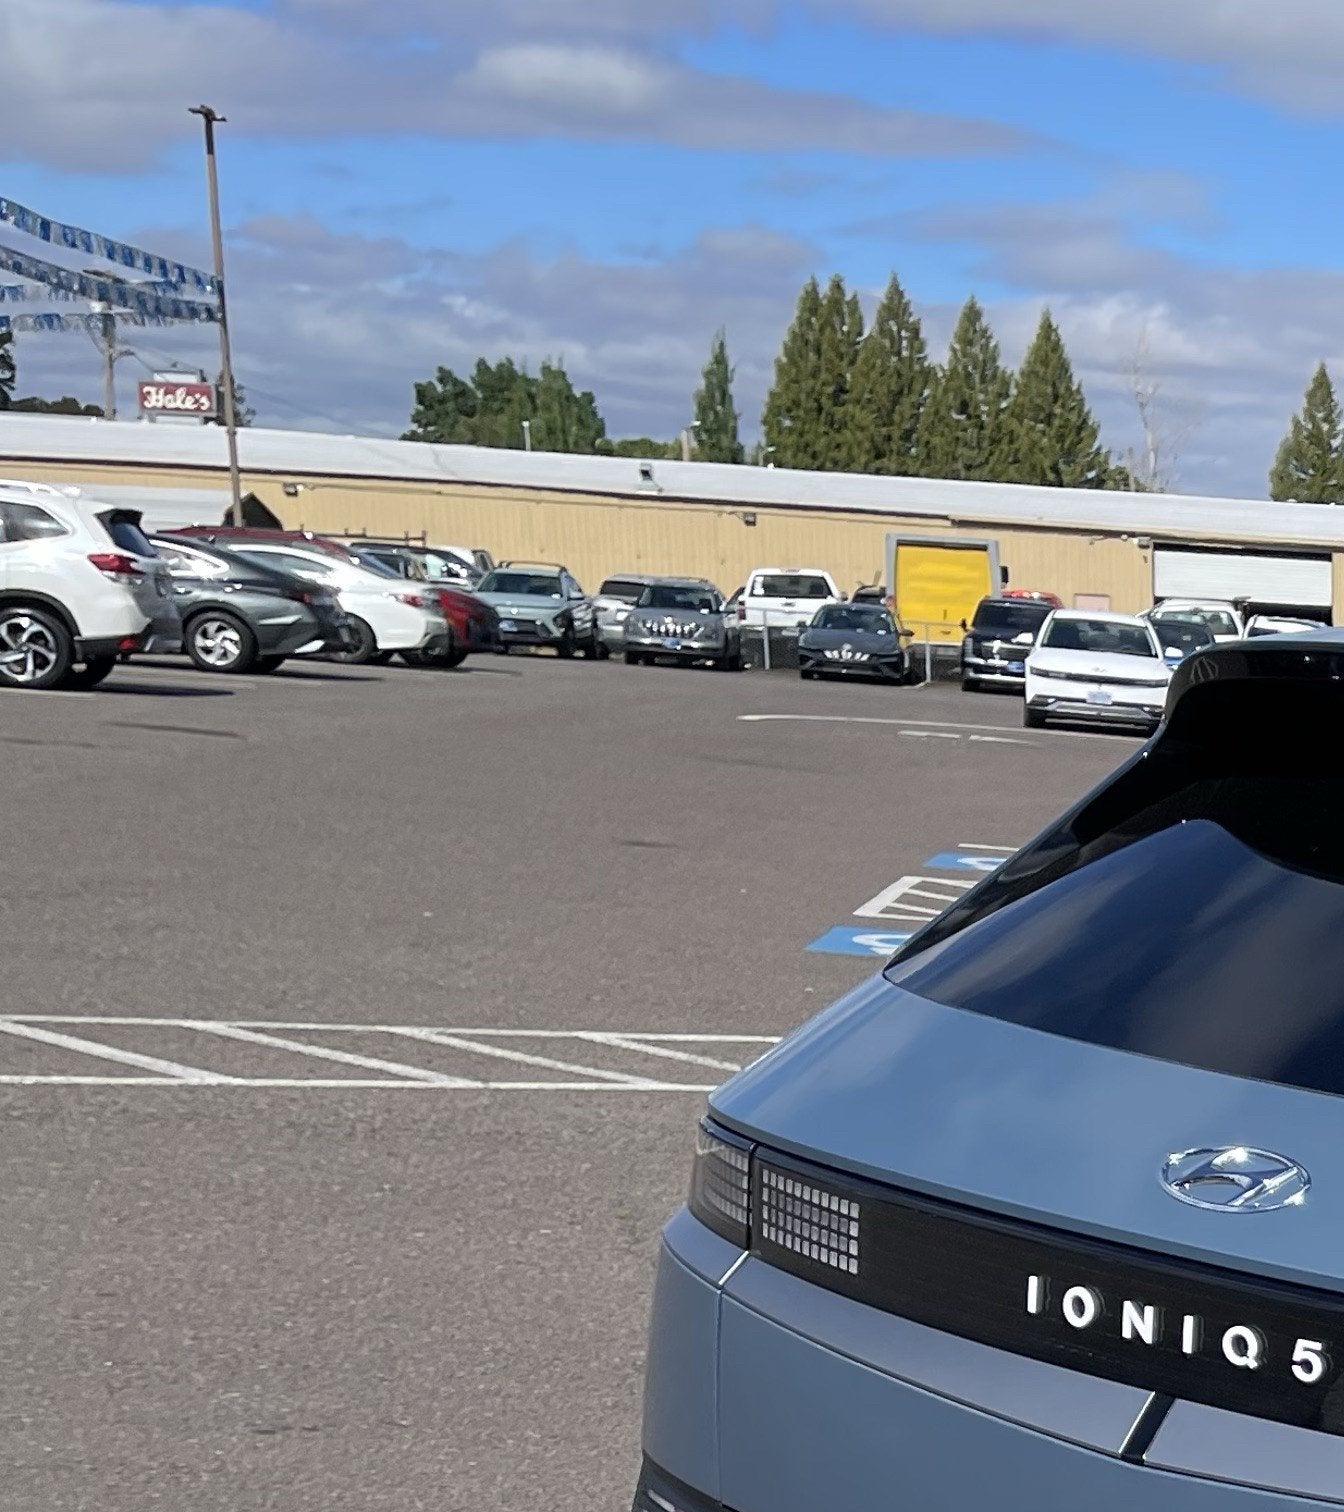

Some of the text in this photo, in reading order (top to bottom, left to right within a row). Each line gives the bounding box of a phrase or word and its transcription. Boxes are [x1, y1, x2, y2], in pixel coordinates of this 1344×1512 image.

[143, 386, 211, 410] Hale's
[1027, 1275, 1328, 1383] IONIQ 5
